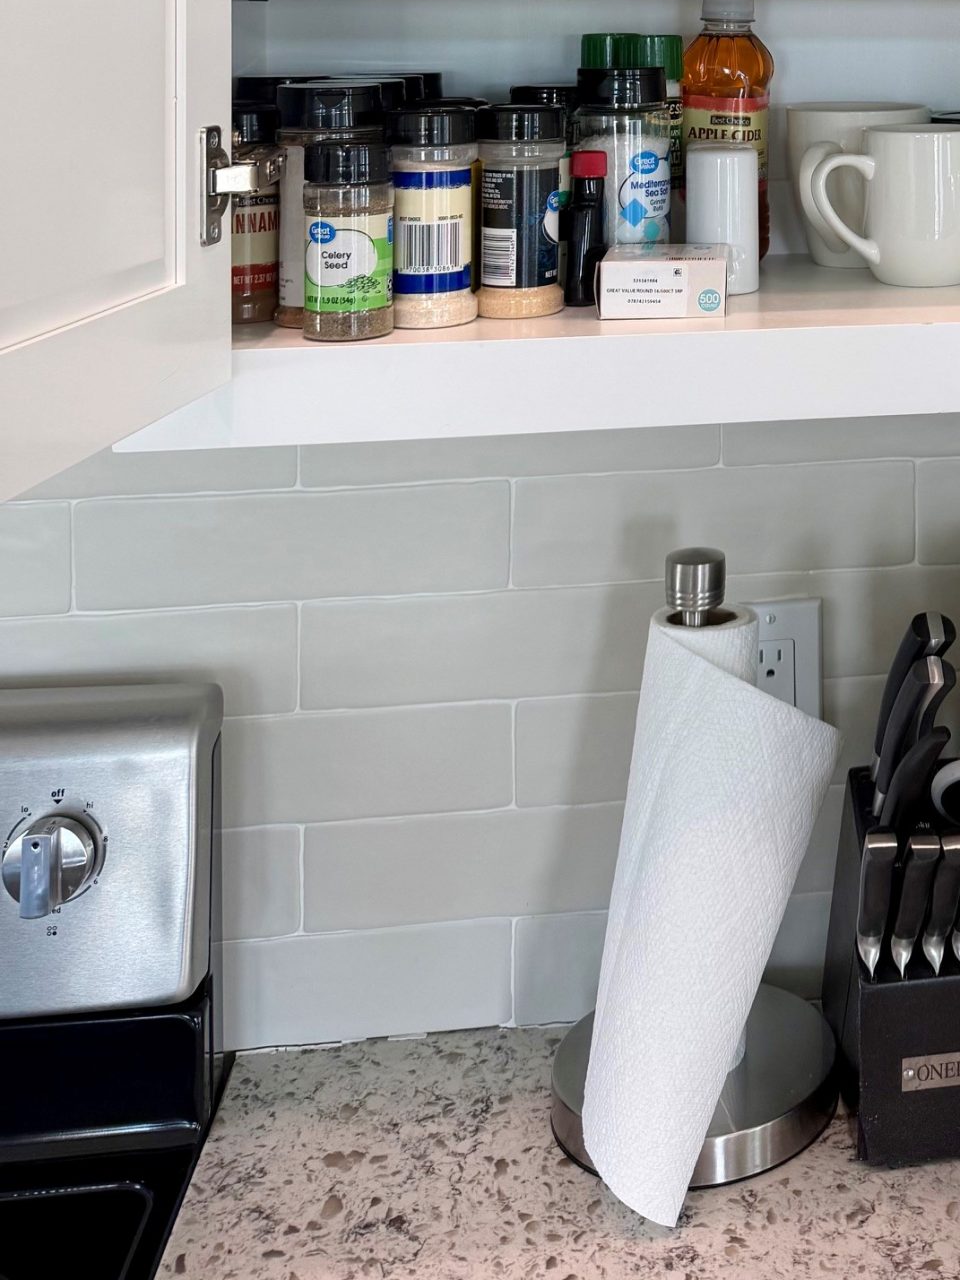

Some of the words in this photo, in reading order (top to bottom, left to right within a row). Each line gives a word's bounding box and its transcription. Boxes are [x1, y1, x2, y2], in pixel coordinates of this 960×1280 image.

[726, 117, 750, 126] Choice
[731, 128, 762, 142] CIDER
[634, 156, 656, 165] Great
[645, 189, 659, 198] Sea
[311, 225, 331, 235] Great
[321, 251, 352, 261] Celery
[324, 261, 348, 270] Seed
[322, 296, 330, 304] 1.9
[331, 296, 339, 304] OZ
[340, 295, 357, 306] (54g)
[699, 293, 719, 304] 500
[51, 788, 65, 798] off
[21, 805, 29, 813] lo
[86, 800, 94, 809] hi
[103, 835, 108, 843] 8
[3, 841, 8, 849] 2
